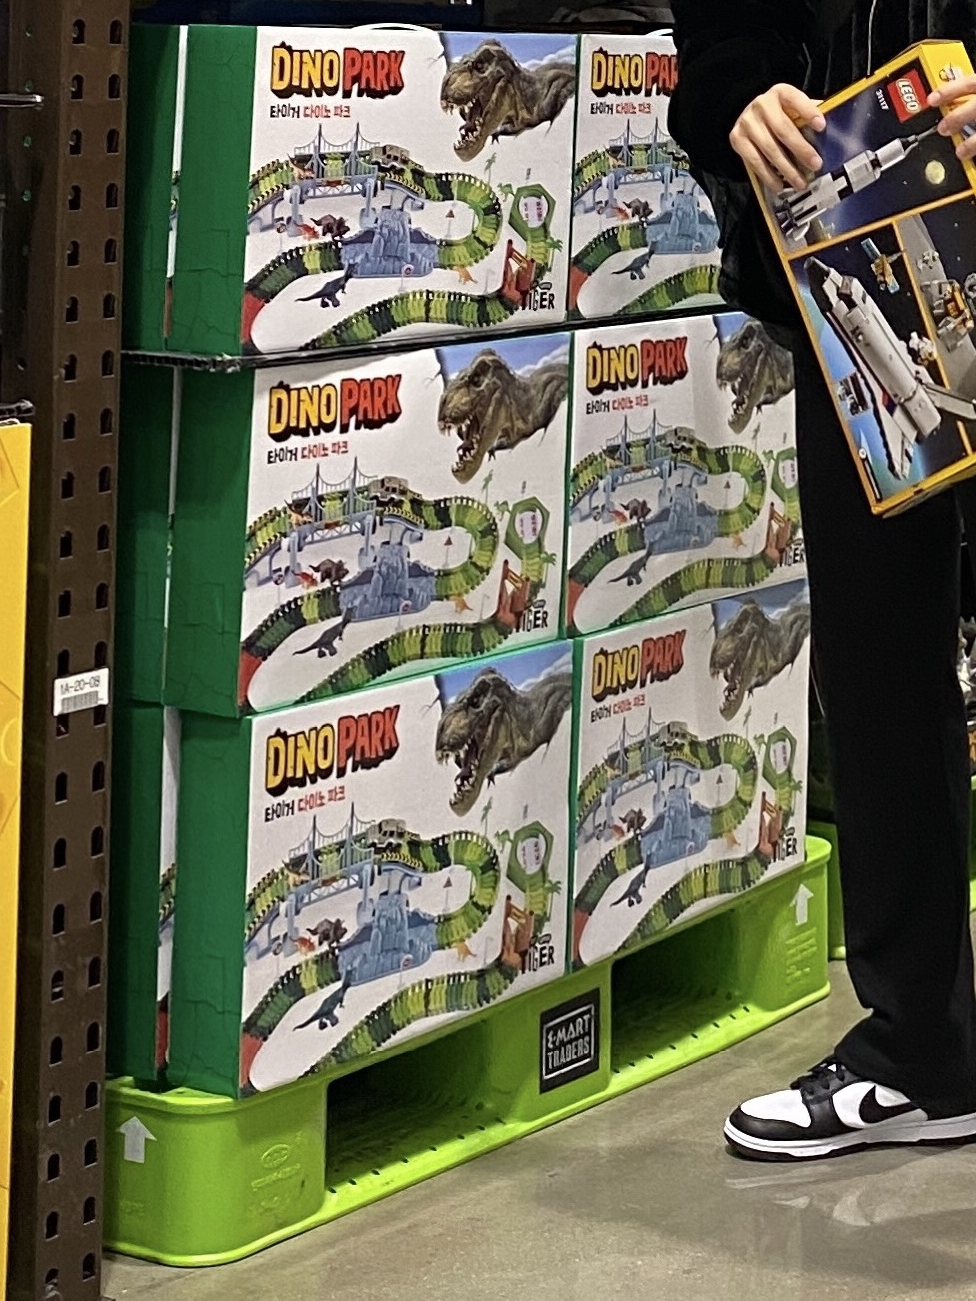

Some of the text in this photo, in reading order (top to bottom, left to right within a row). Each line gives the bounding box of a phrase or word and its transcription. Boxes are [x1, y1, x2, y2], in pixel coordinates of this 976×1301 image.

[271, 42, 405, 99] DINO PARK
[591, 46, 679, 97] DINO PAR
[896, 78, 921, 114] LEGO
[269, 104, 300, 119] 타이거
[586, 336, 689, 396] DINO PARK
[268, 374, 402, 443] DINO PARK
[267, 446, 298, 464] 타이거
[592, 629, 687, 703] DINO PARK
[266, 704, 401, 797] DINO PARK
[264, 800, 295, 823] 타이거
[547, 1036, 591, 1070] TRADERS
